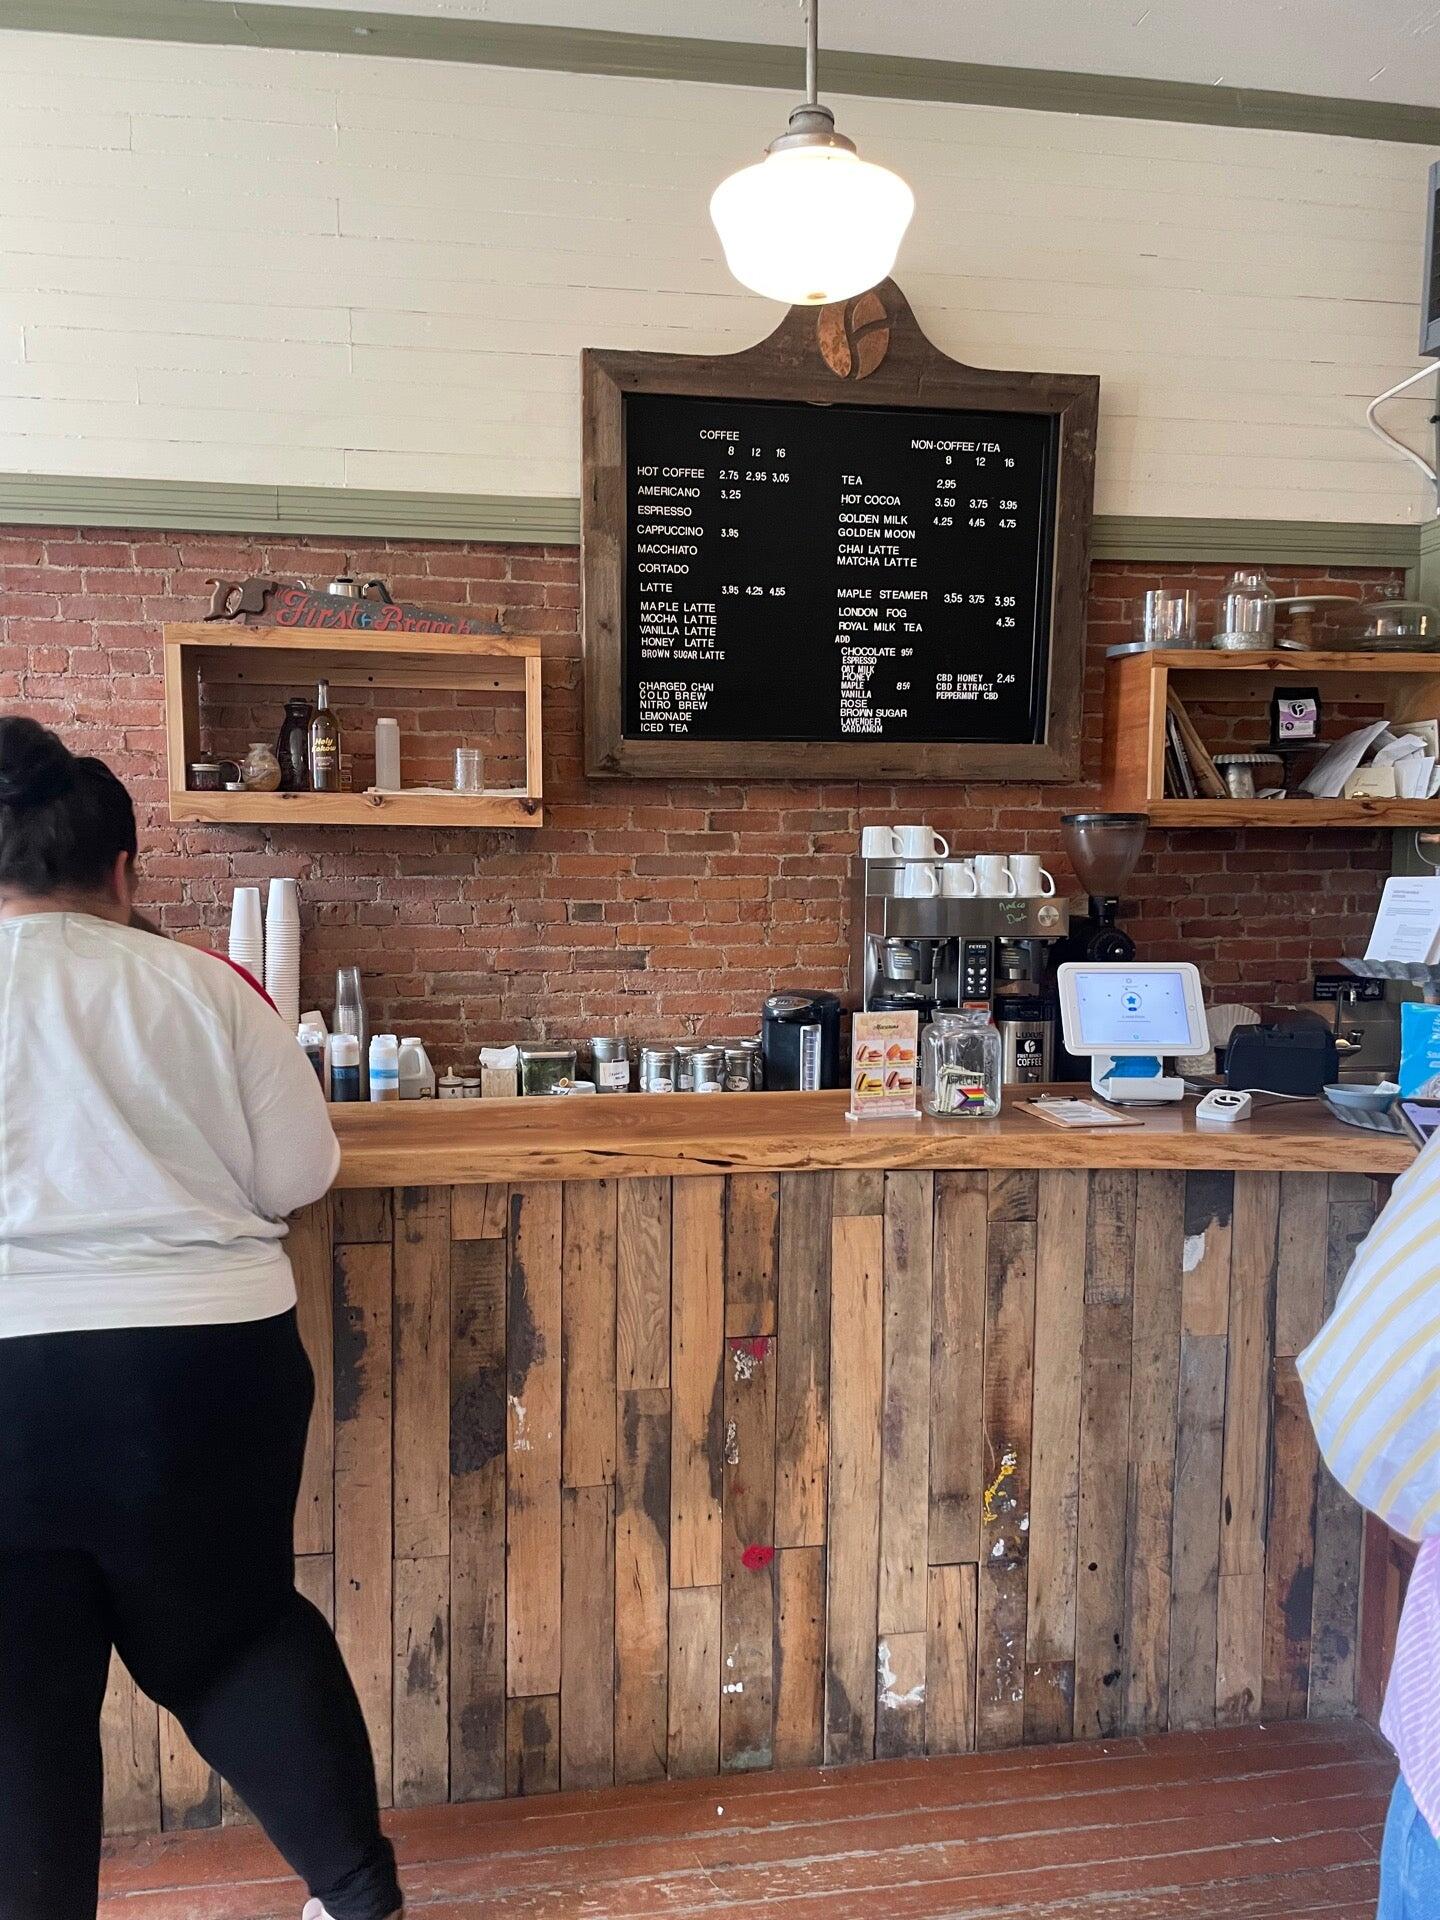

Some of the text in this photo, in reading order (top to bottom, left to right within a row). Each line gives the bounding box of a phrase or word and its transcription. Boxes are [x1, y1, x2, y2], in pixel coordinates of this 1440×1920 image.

[700, 430, 739, 440] COFFEE
[728, 446, 785, 458] 8 12 16
[982, 443, 1000, 452] TEA
[946, 456, 1014, 467] 8 12 16
[638, 466, 789, 483] HOT COFFEE 2.75 2.95 3.05
[842, 475, 956, 489] TEA 2.95
[638, 486, 741, 499] AMERICANO 3.25
[841, 494, 1017, 509] HOT COCOA 3.50 3.75 3.95
[638, 506, 692, 516] ESPRESSO
[839, 513, 879, 523] GOLDEN
[884, 515, 907, 524] MILK
[933, 517, 952, 526] 4.25
[999, 519, 1016, 528] 4.75
[637, 525, 703, 536] CAPPUCCINO
[838, 528, 915, 539] GOLDEN MOON
[638, 544, 697, 555] MACCHIATO
[839, 544, 899, 555] CHAI LATTE
[837, 556, 917, 567] MATCHA LATTE
[639, 563, 689, 574] CORTADO
[641, 583, 672, 592] LATTE
[837, 589, 1015, 606] MAPLE STEAMER 3.55 3.75 3.95
[641, 602, 715, 612] MAPLE LATTE
[839, 607, 906, 617] LONDON FOG
[641, 613, 717, 624] MOCHA LATTE
[640, 626, 716, 636] VANILLA LATTE
[839, 622, 922, 632] ROYAL MILK TEA
[642, 637, 714, 647] HONEY LATTE
[835, 635, 850, 643] ADD
[642, 649, 725, 660] BROWN SUGAR LATTE
[841, 647, 895, 656] CHOCOLATE
[843, 657, 877, 665] ESPRESSO
[842, 673, 871, 681] HONEY
[937, 673, 1015, 683] CBD HONEY 2.45
[639, 682, 714, 692] CHARGED CHAI
[640, 691, 706, 701] COLD BREW
[841, 690, 871, 698] VANILLA
[936, 692, 979, 700] PEPPERMINT
[640, 701, 708, 710] NITRO BREW
[841, 700, 867, 708] ROSE
[640, 712, 691, 721] LEMONADE
[840, 709, 907, 717] BROWN SUGAR
[841, 718, 881, 726] LAVENDER
[641, 723, 688, 732] ICED TEA
[1017, 1057, 1042, 1067] COFFEE
